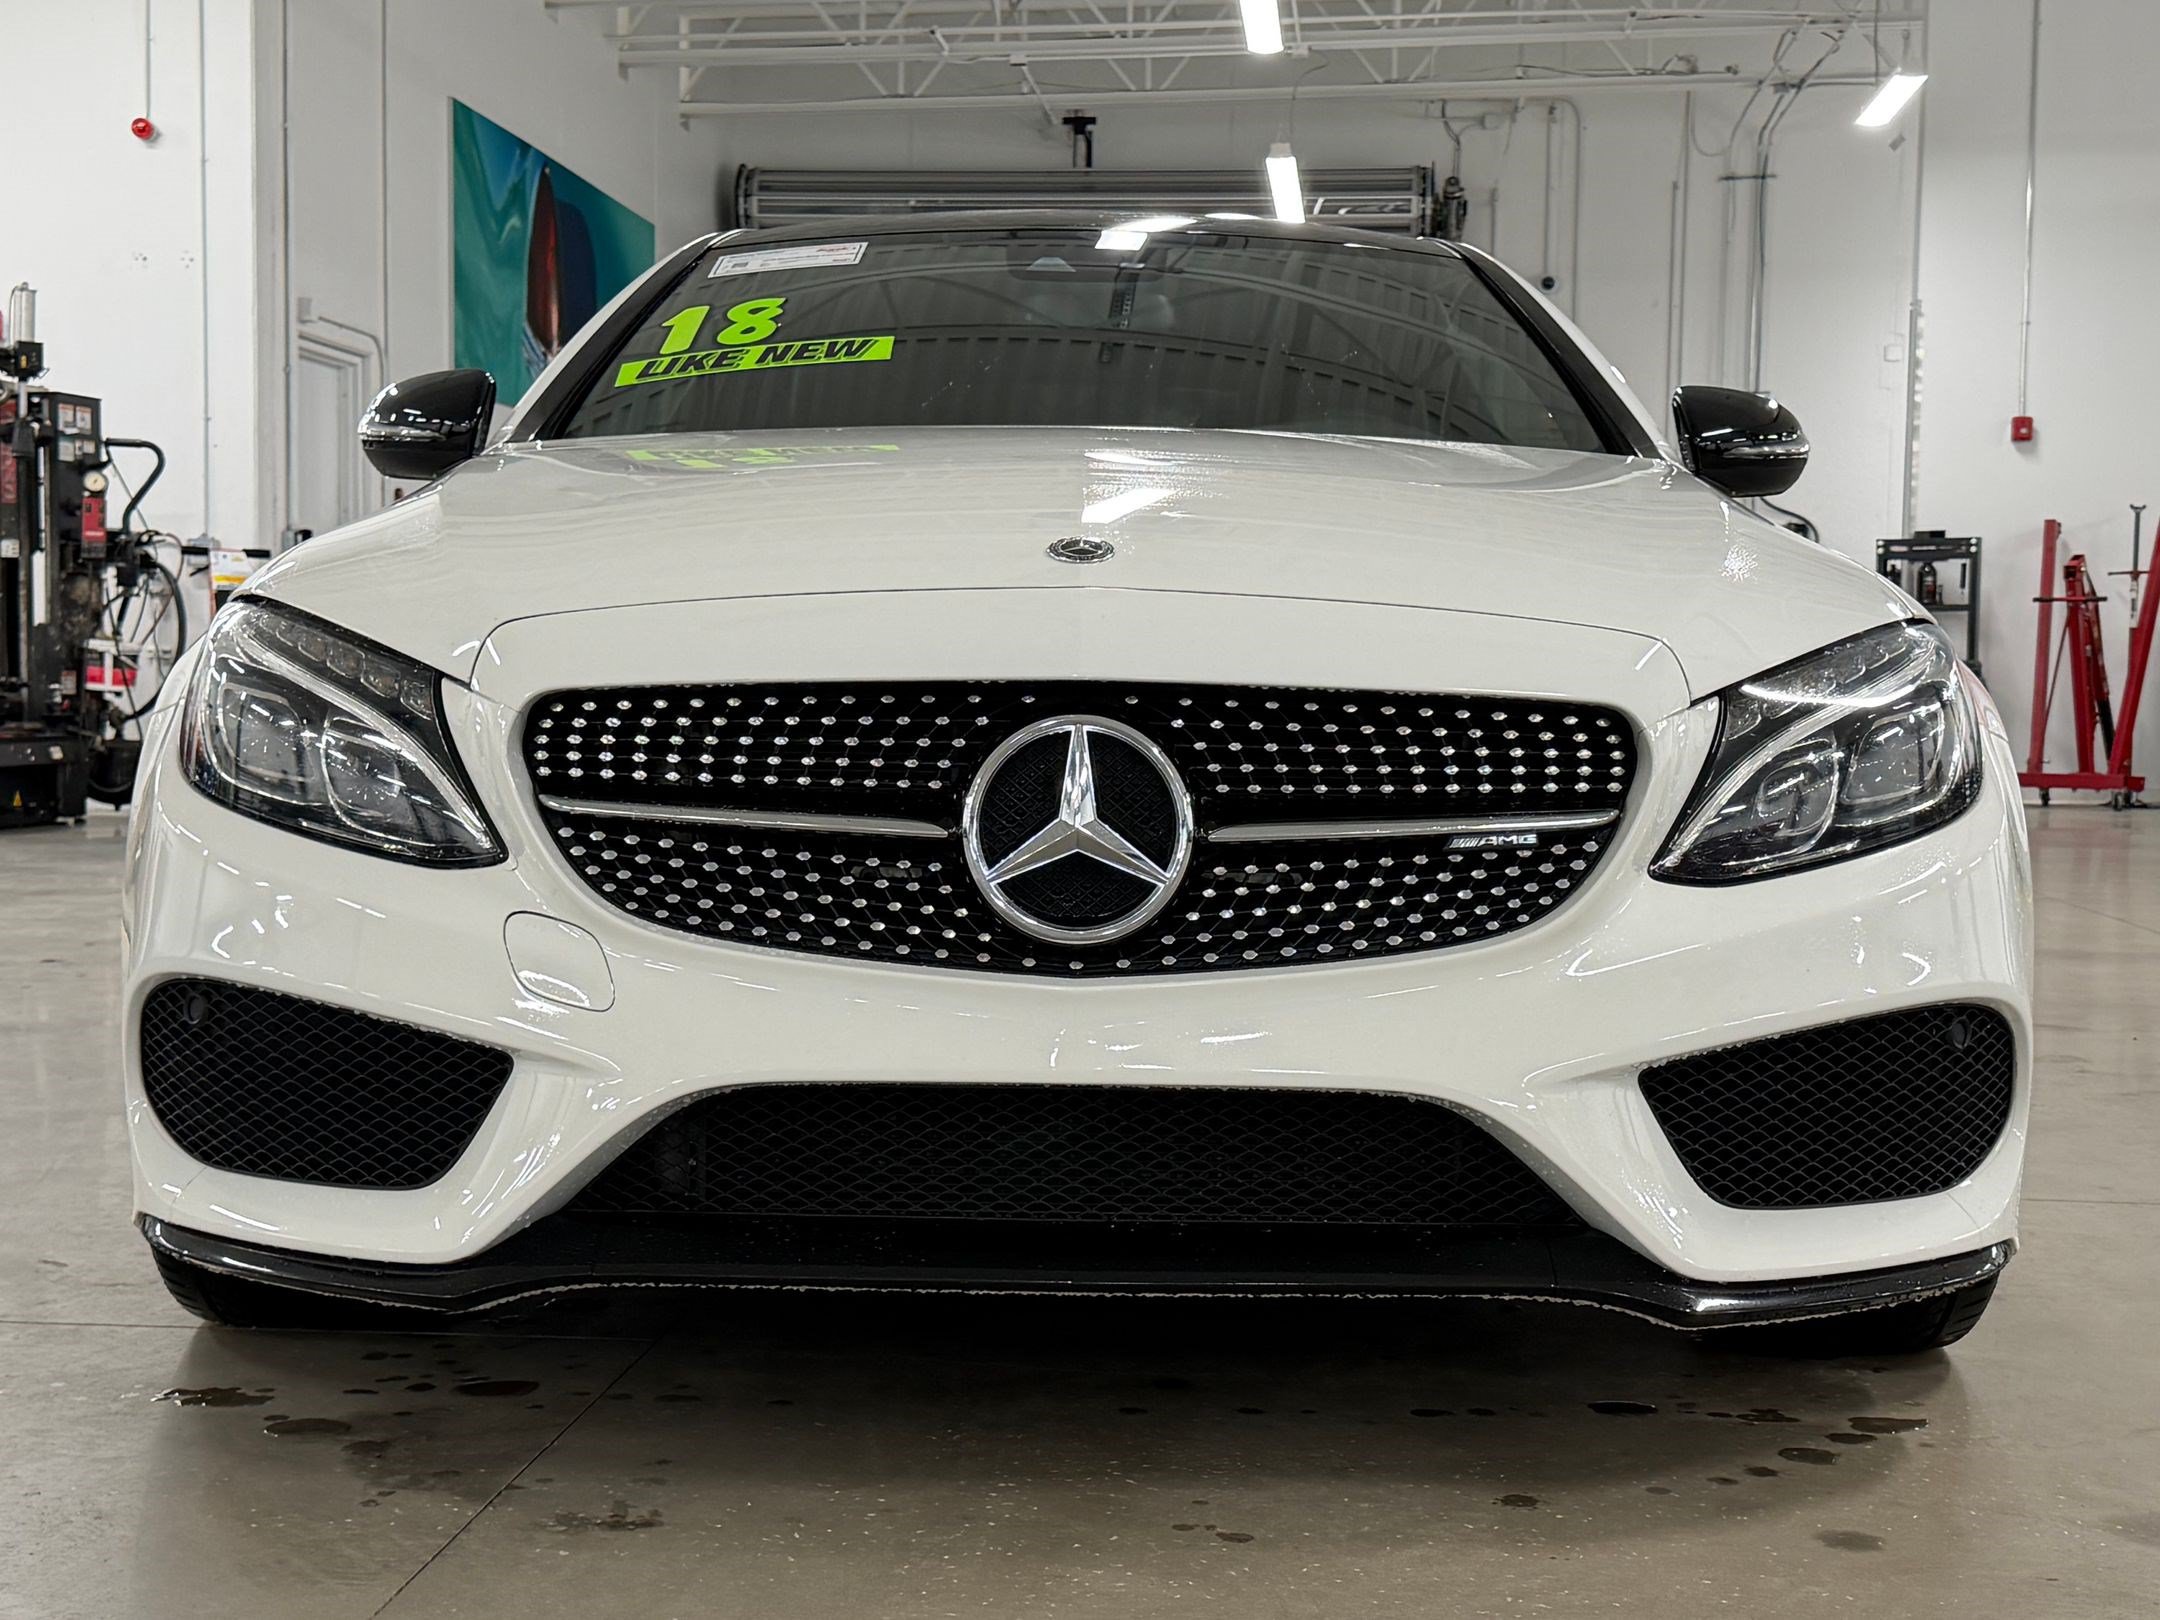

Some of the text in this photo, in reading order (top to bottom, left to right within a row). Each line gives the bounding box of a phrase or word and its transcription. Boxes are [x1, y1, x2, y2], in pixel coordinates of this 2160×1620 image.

[659, 297, 787, 355] 18
[635, 337, 878, 382] LIKE NEW
[1477, 833, 1538, 847] AMG
